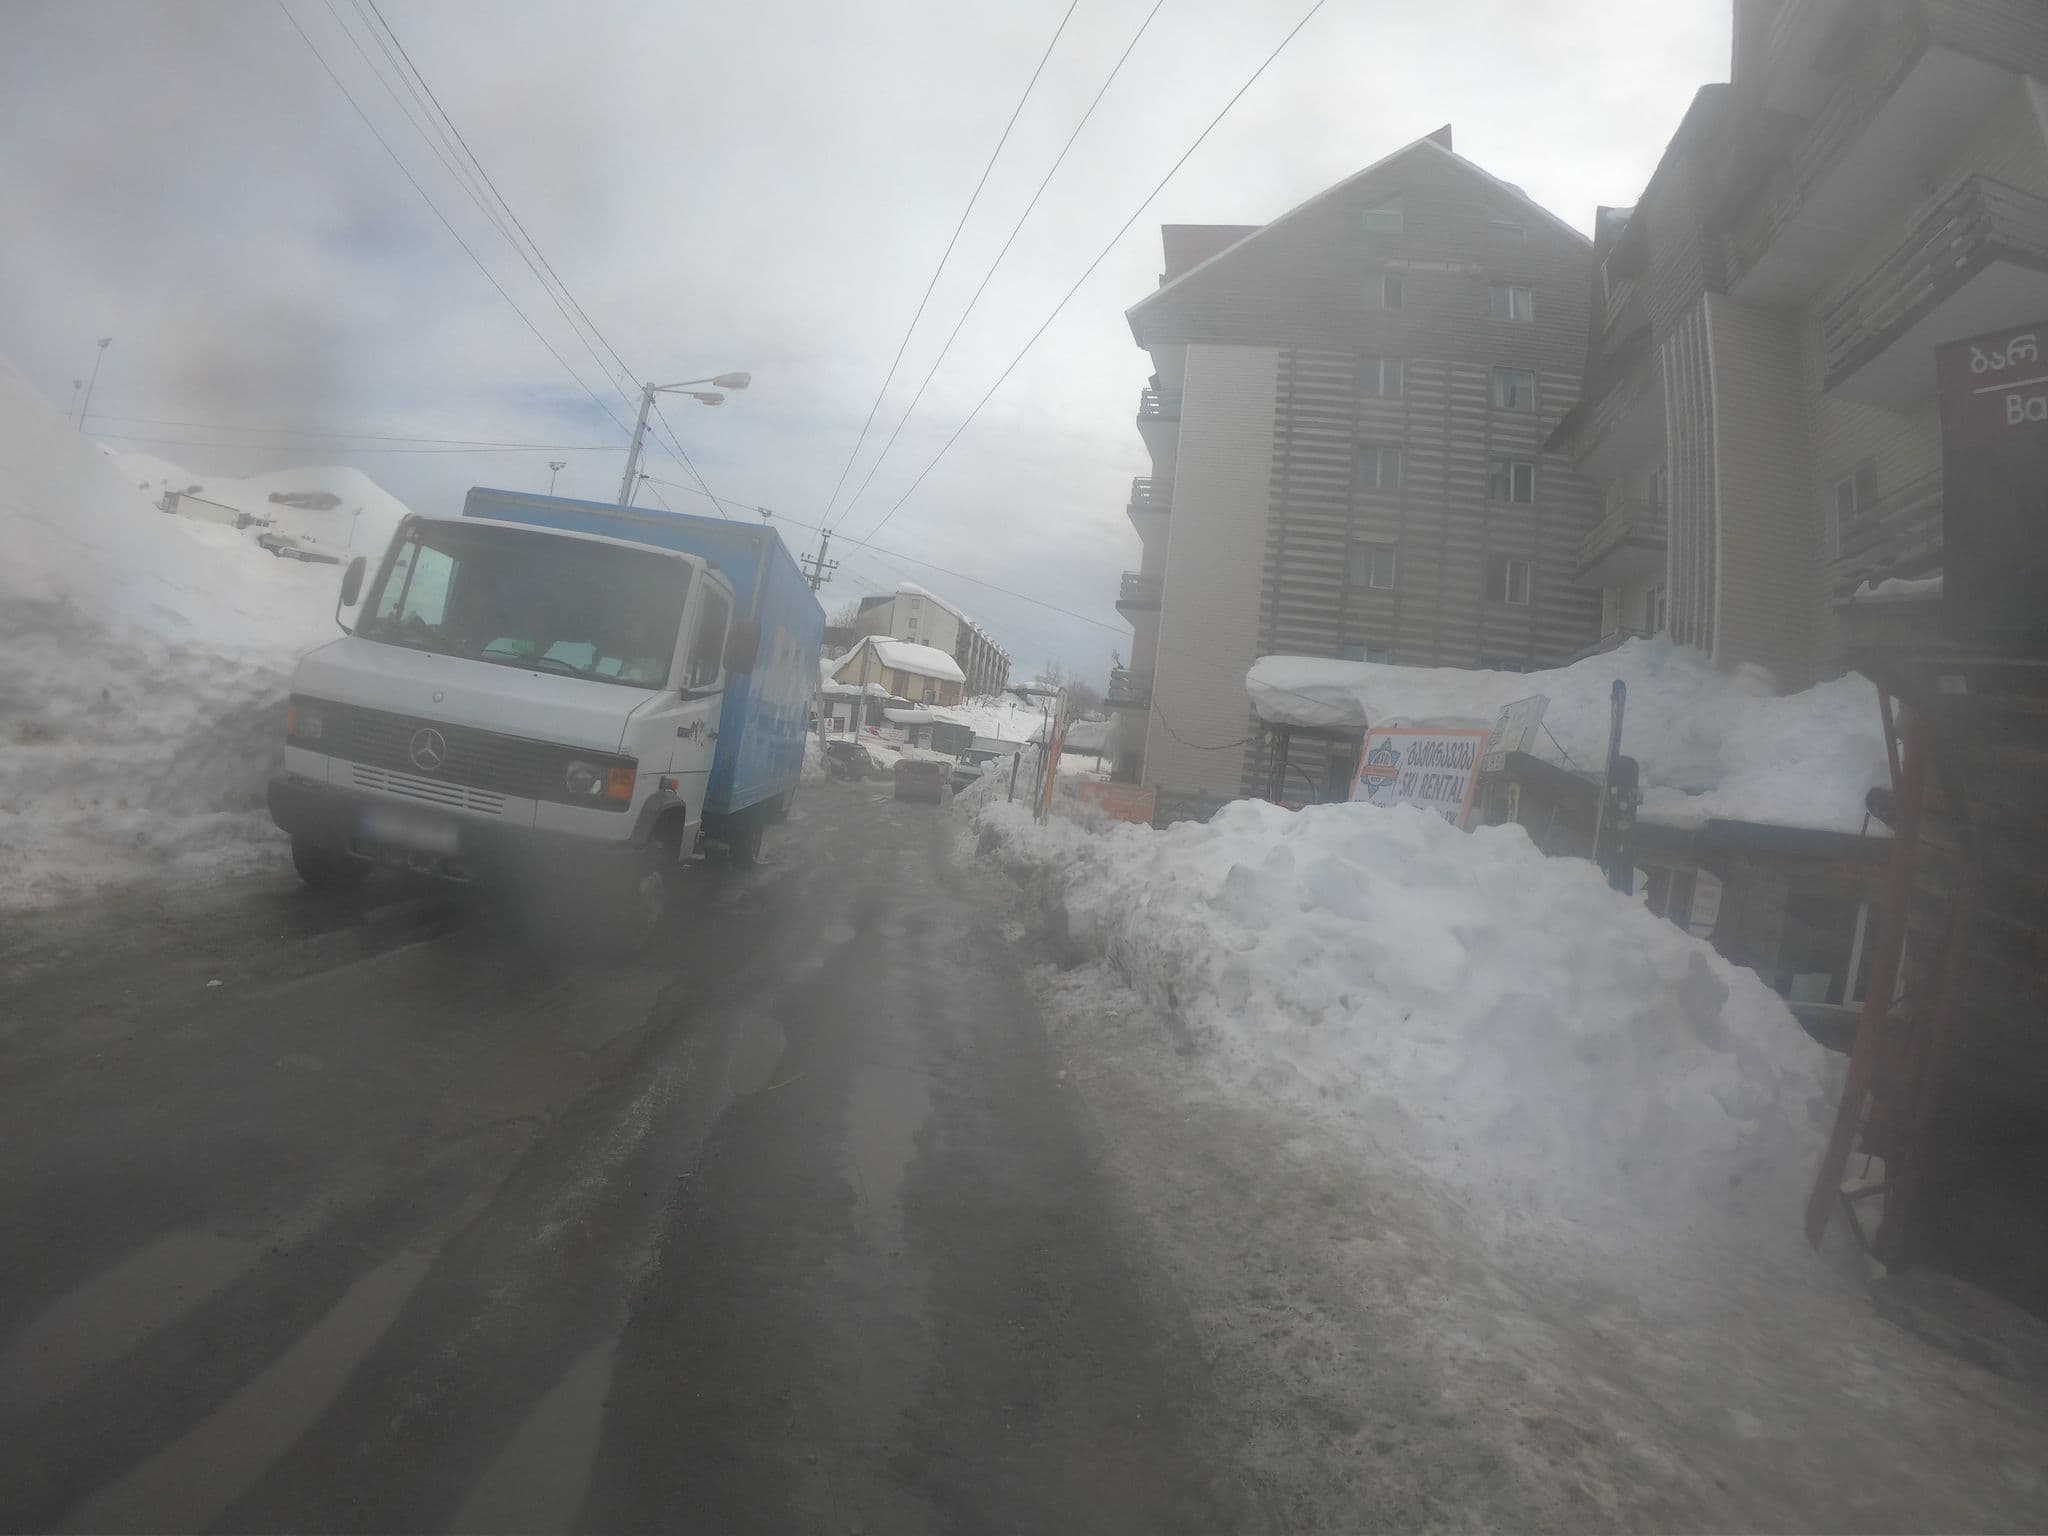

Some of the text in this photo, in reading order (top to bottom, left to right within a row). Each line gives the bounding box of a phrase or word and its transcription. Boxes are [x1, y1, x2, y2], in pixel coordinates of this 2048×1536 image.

[1970, 334, 2039, 374] ბარ
[1402, 772, 1465, 803] SKI RENTAL
